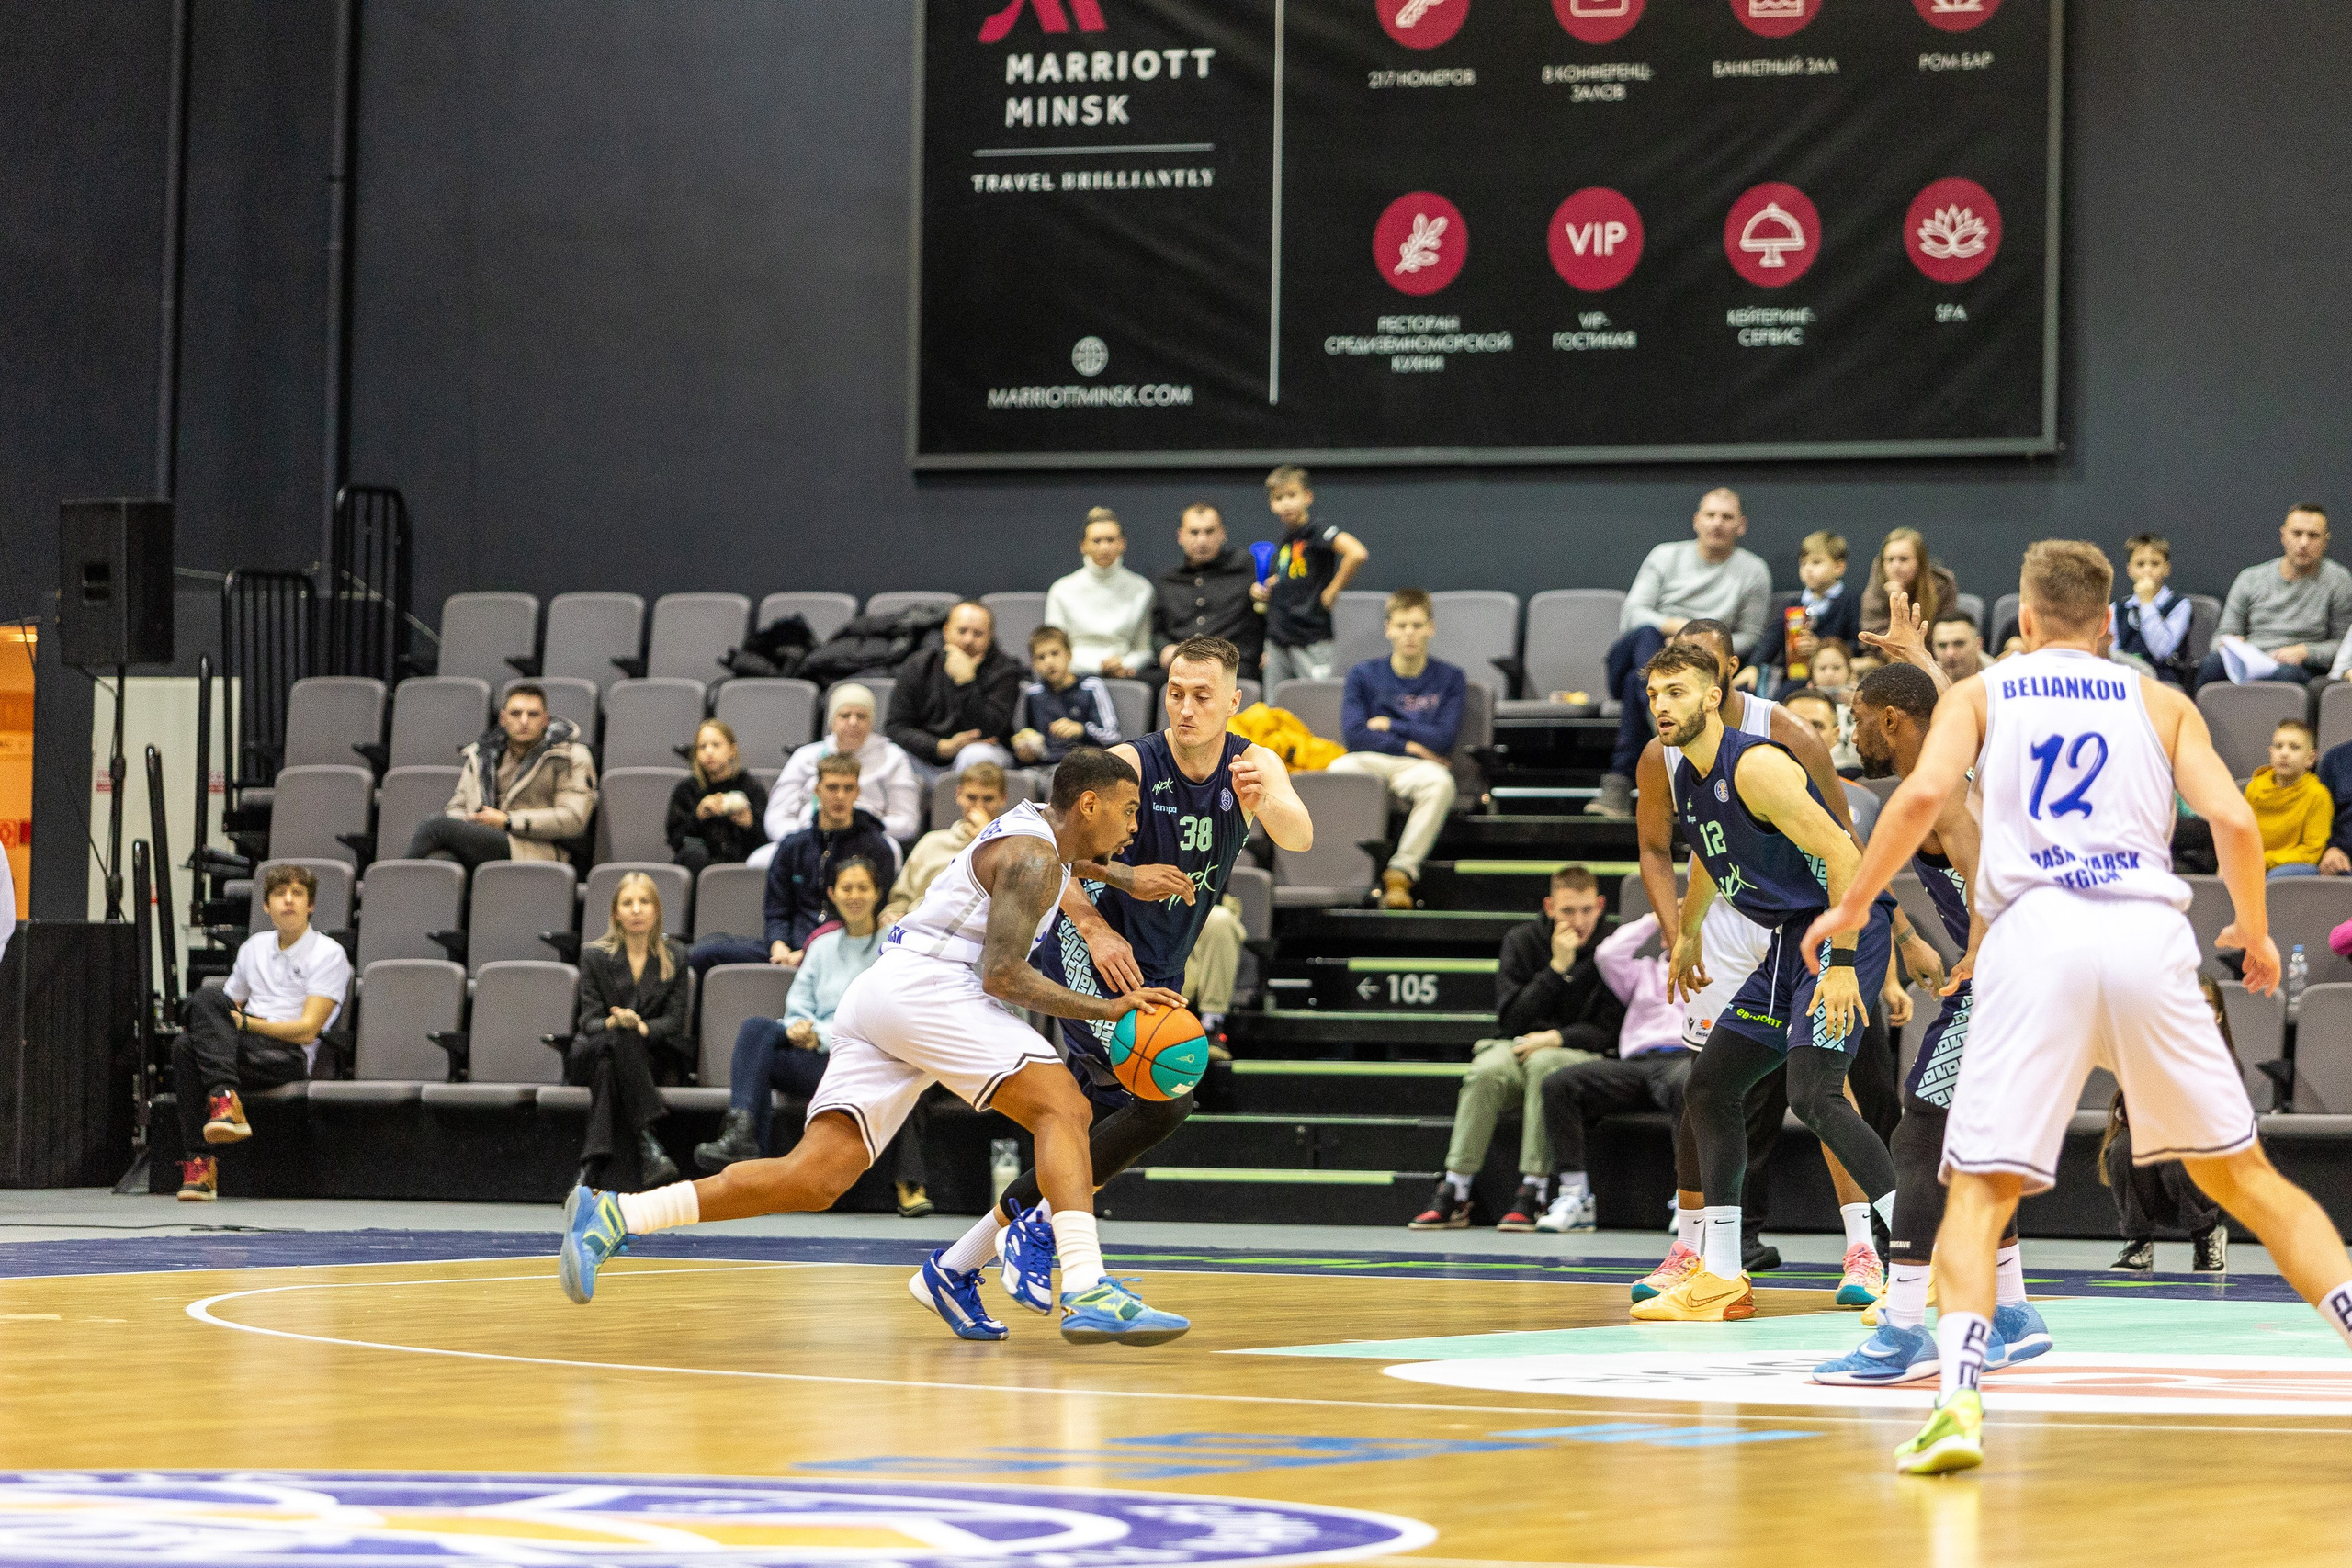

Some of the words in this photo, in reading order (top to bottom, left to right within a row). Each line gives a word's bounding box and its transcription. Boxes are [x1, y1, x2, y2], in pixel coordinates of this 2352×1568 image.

[1005, 48, 1216, 85] MARRIOTT
[1805, 56, 1838, 75] ЗАЛ
[1005, 94, 1130, 128] MINSK
[971, 172, 1054, 193] TRAVEL
[1061, 168, 1214, 190] BRILLIANTLY
[1565, 220, 1628, 257] VIP
[1377, 315, 1461, 334] РЕСТОРАН
[1935, 303, 1968, 322] SPA
[1324, 331, 1514, 355] СРЕДИЗЕМНОМОРСКОЙ
[1552, 331, 1637, 351] ГОСТИНАЯ
[1737, 327, 1804, 347] СЕРВИС
[1391, 355, 1445, 373] КУХНИ
[987, 383, 1193, 409] MARRIOTTMINSK.COM
[2002, 676, 2127, 701] BELIANKOU
[2028, 731, 2109, 821] 12
[1179, 815, 1213, 852] 38
[1699, 820, 1727, 857] 12
[1386, 974, 1438, 1004] 105
